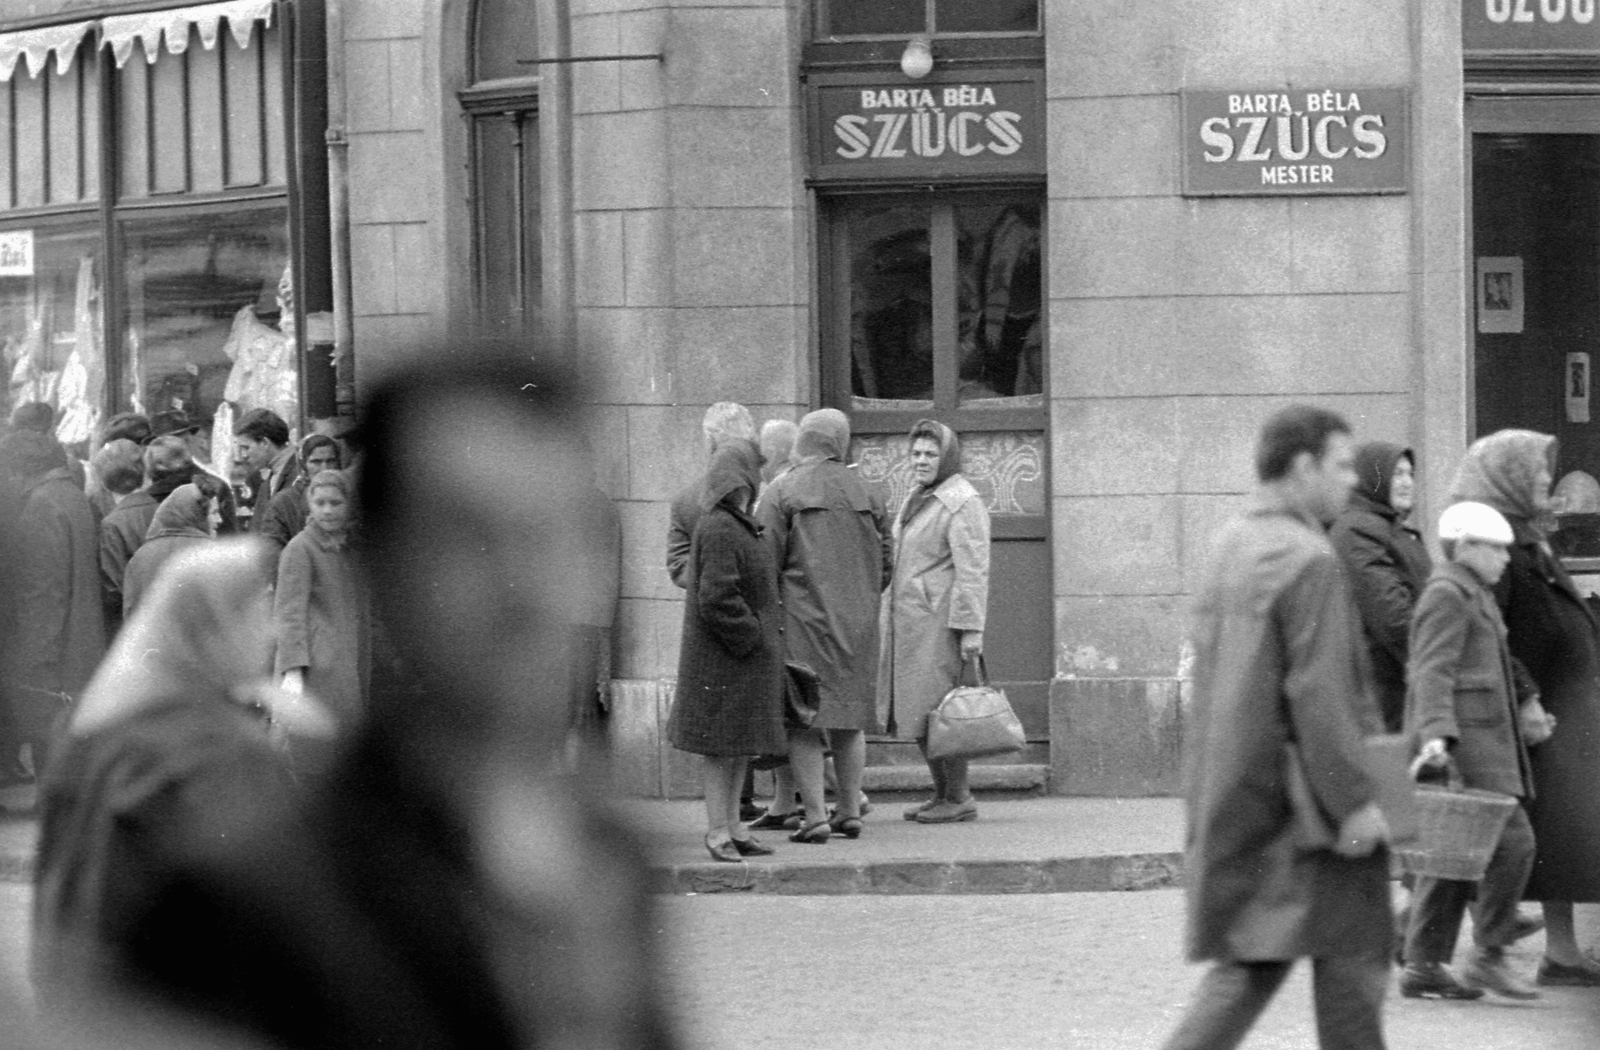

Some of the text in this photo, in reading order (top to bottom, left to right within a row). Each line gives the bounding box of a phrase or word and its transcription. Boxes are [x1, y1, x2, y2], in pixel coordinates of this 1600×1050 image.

[861, 85, 996, 108] BARTA BÉLA
[1229, 90, 1361, 113] BARTA BÉLA
[1261, 165, 1334, 184] MESTER
